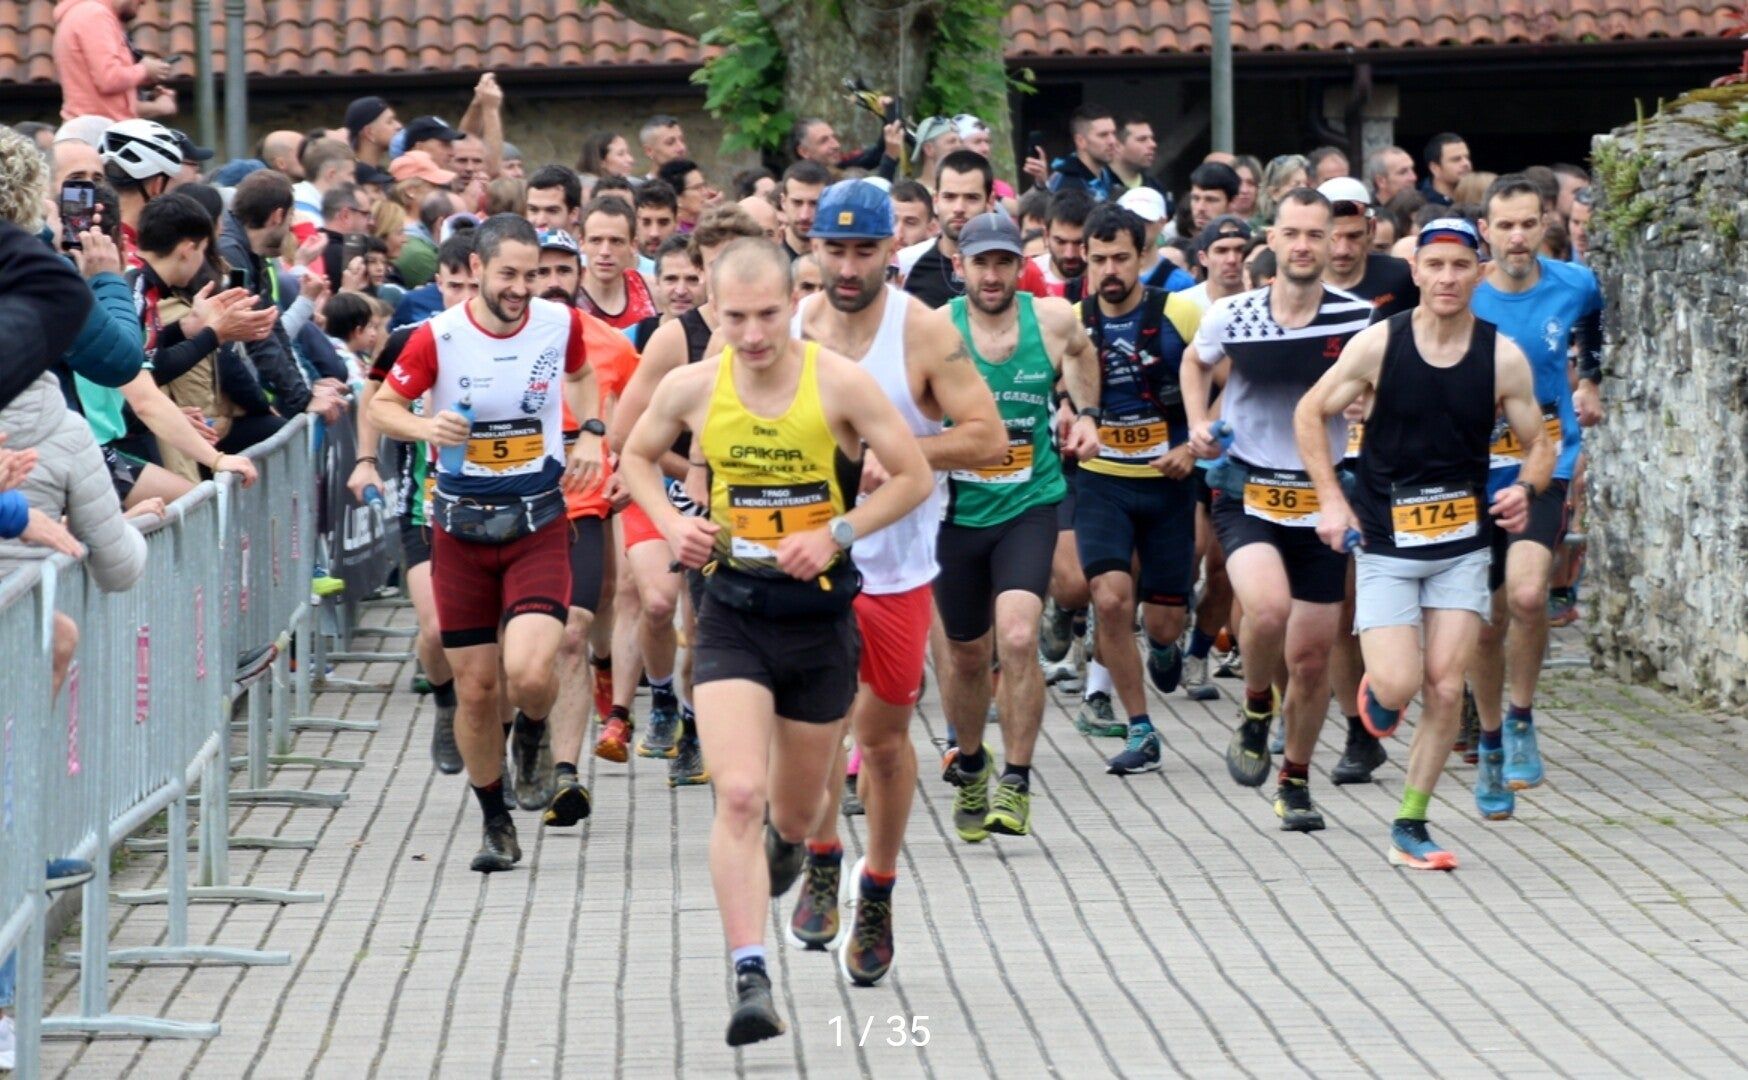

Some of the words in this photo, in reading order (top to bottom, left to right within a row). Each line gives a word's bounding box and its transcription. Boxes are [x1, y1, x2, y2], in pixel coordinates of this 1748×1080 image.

[1110, 427, 1150, 444] 189
[493, 440, 509, 459] 5
[1266, 488, 1297, 508] 36
[768, 509, 784, 533] 1
[1410, 502, 1457, 526] 174
